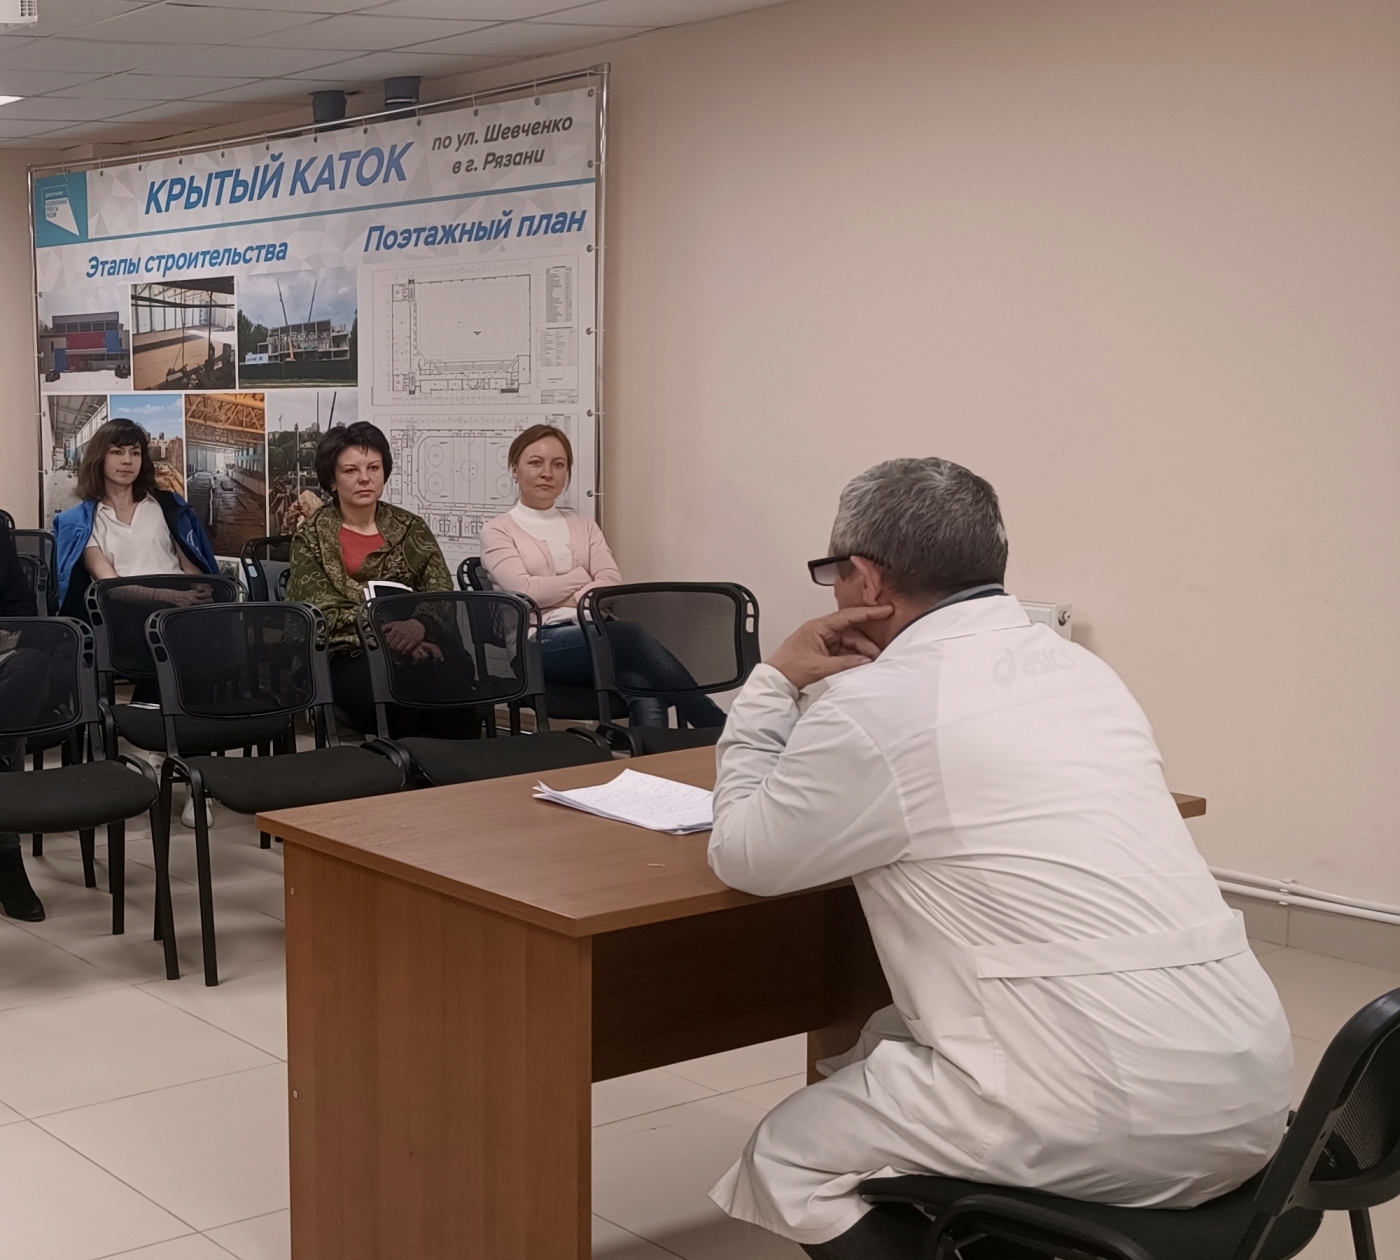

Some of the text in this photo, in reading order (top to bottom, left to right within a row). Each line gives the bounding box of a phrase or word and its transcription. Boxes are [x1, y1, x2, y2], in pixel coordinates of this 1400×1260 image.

[432, 116, 573, 152] по ул. Шевченко
[144, 141, 415, 215] КРЫТЫЙ КАТОК
[452, 149, 545, 174] в г. Рязани
[363, 209, 587, 252] Поэтажный план
[86, 241, 288, 278] Этапы строительства
[1020, 646, 1077, 676] asics
